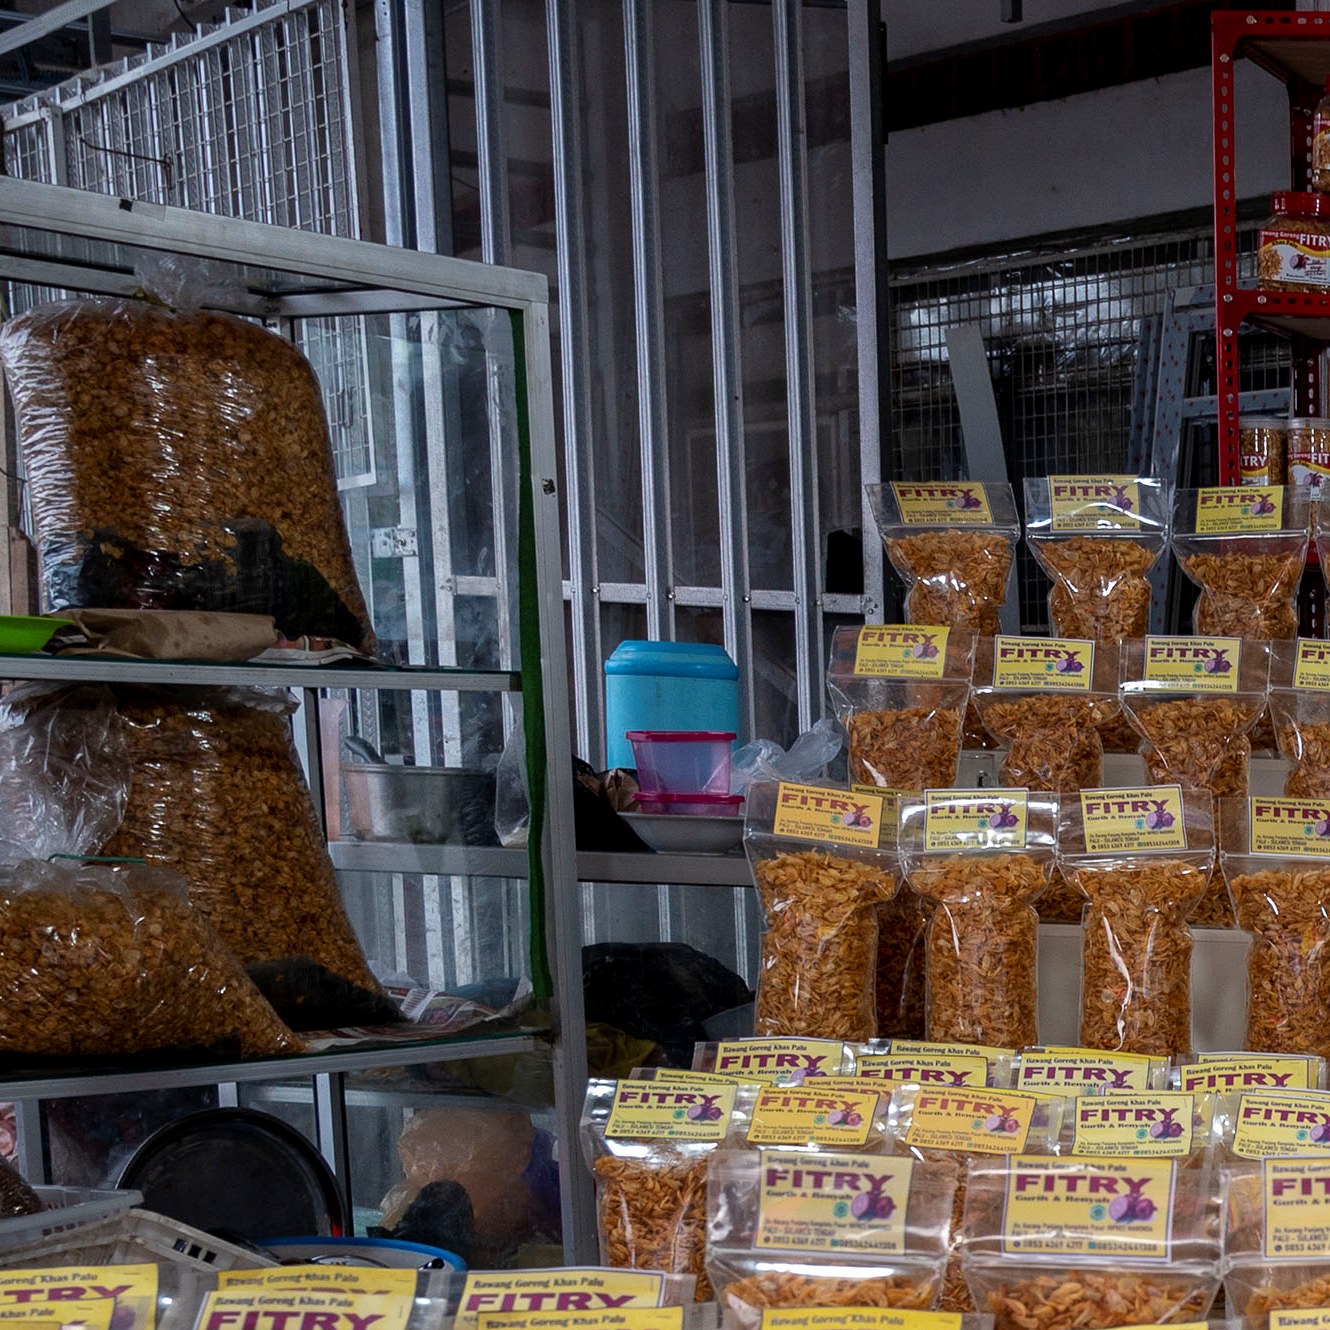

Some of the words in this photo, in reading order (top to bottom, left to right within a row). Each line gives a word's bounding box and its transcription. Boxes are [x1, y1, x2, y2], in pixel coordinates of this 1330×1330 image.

[1054, 486, 1128, 496] FITRY
[1201, 493, 1273, 505] FITRY
[863, 632, 937, 644] FITRY
[1000, 648, 1081, 659] FITRY
[782, 793, 871, 813] FITRY
[1086, 799, 1169, 815] FITRY
[720, 1054, 828, 1069] FITRY
[1024, 1066, 1135, 1081] FITRY
[619, 1092, 723, 1105] FITRY
[760, 1096, 863, 1110] FITRY
[918, 1097, 1020, 1116] FITRY
[1080, 1108, 1182, 1122] FITRY
[766, 1169, 893, 1192] FITRY
[1015, 1174, 1152, 1194] FITRY
